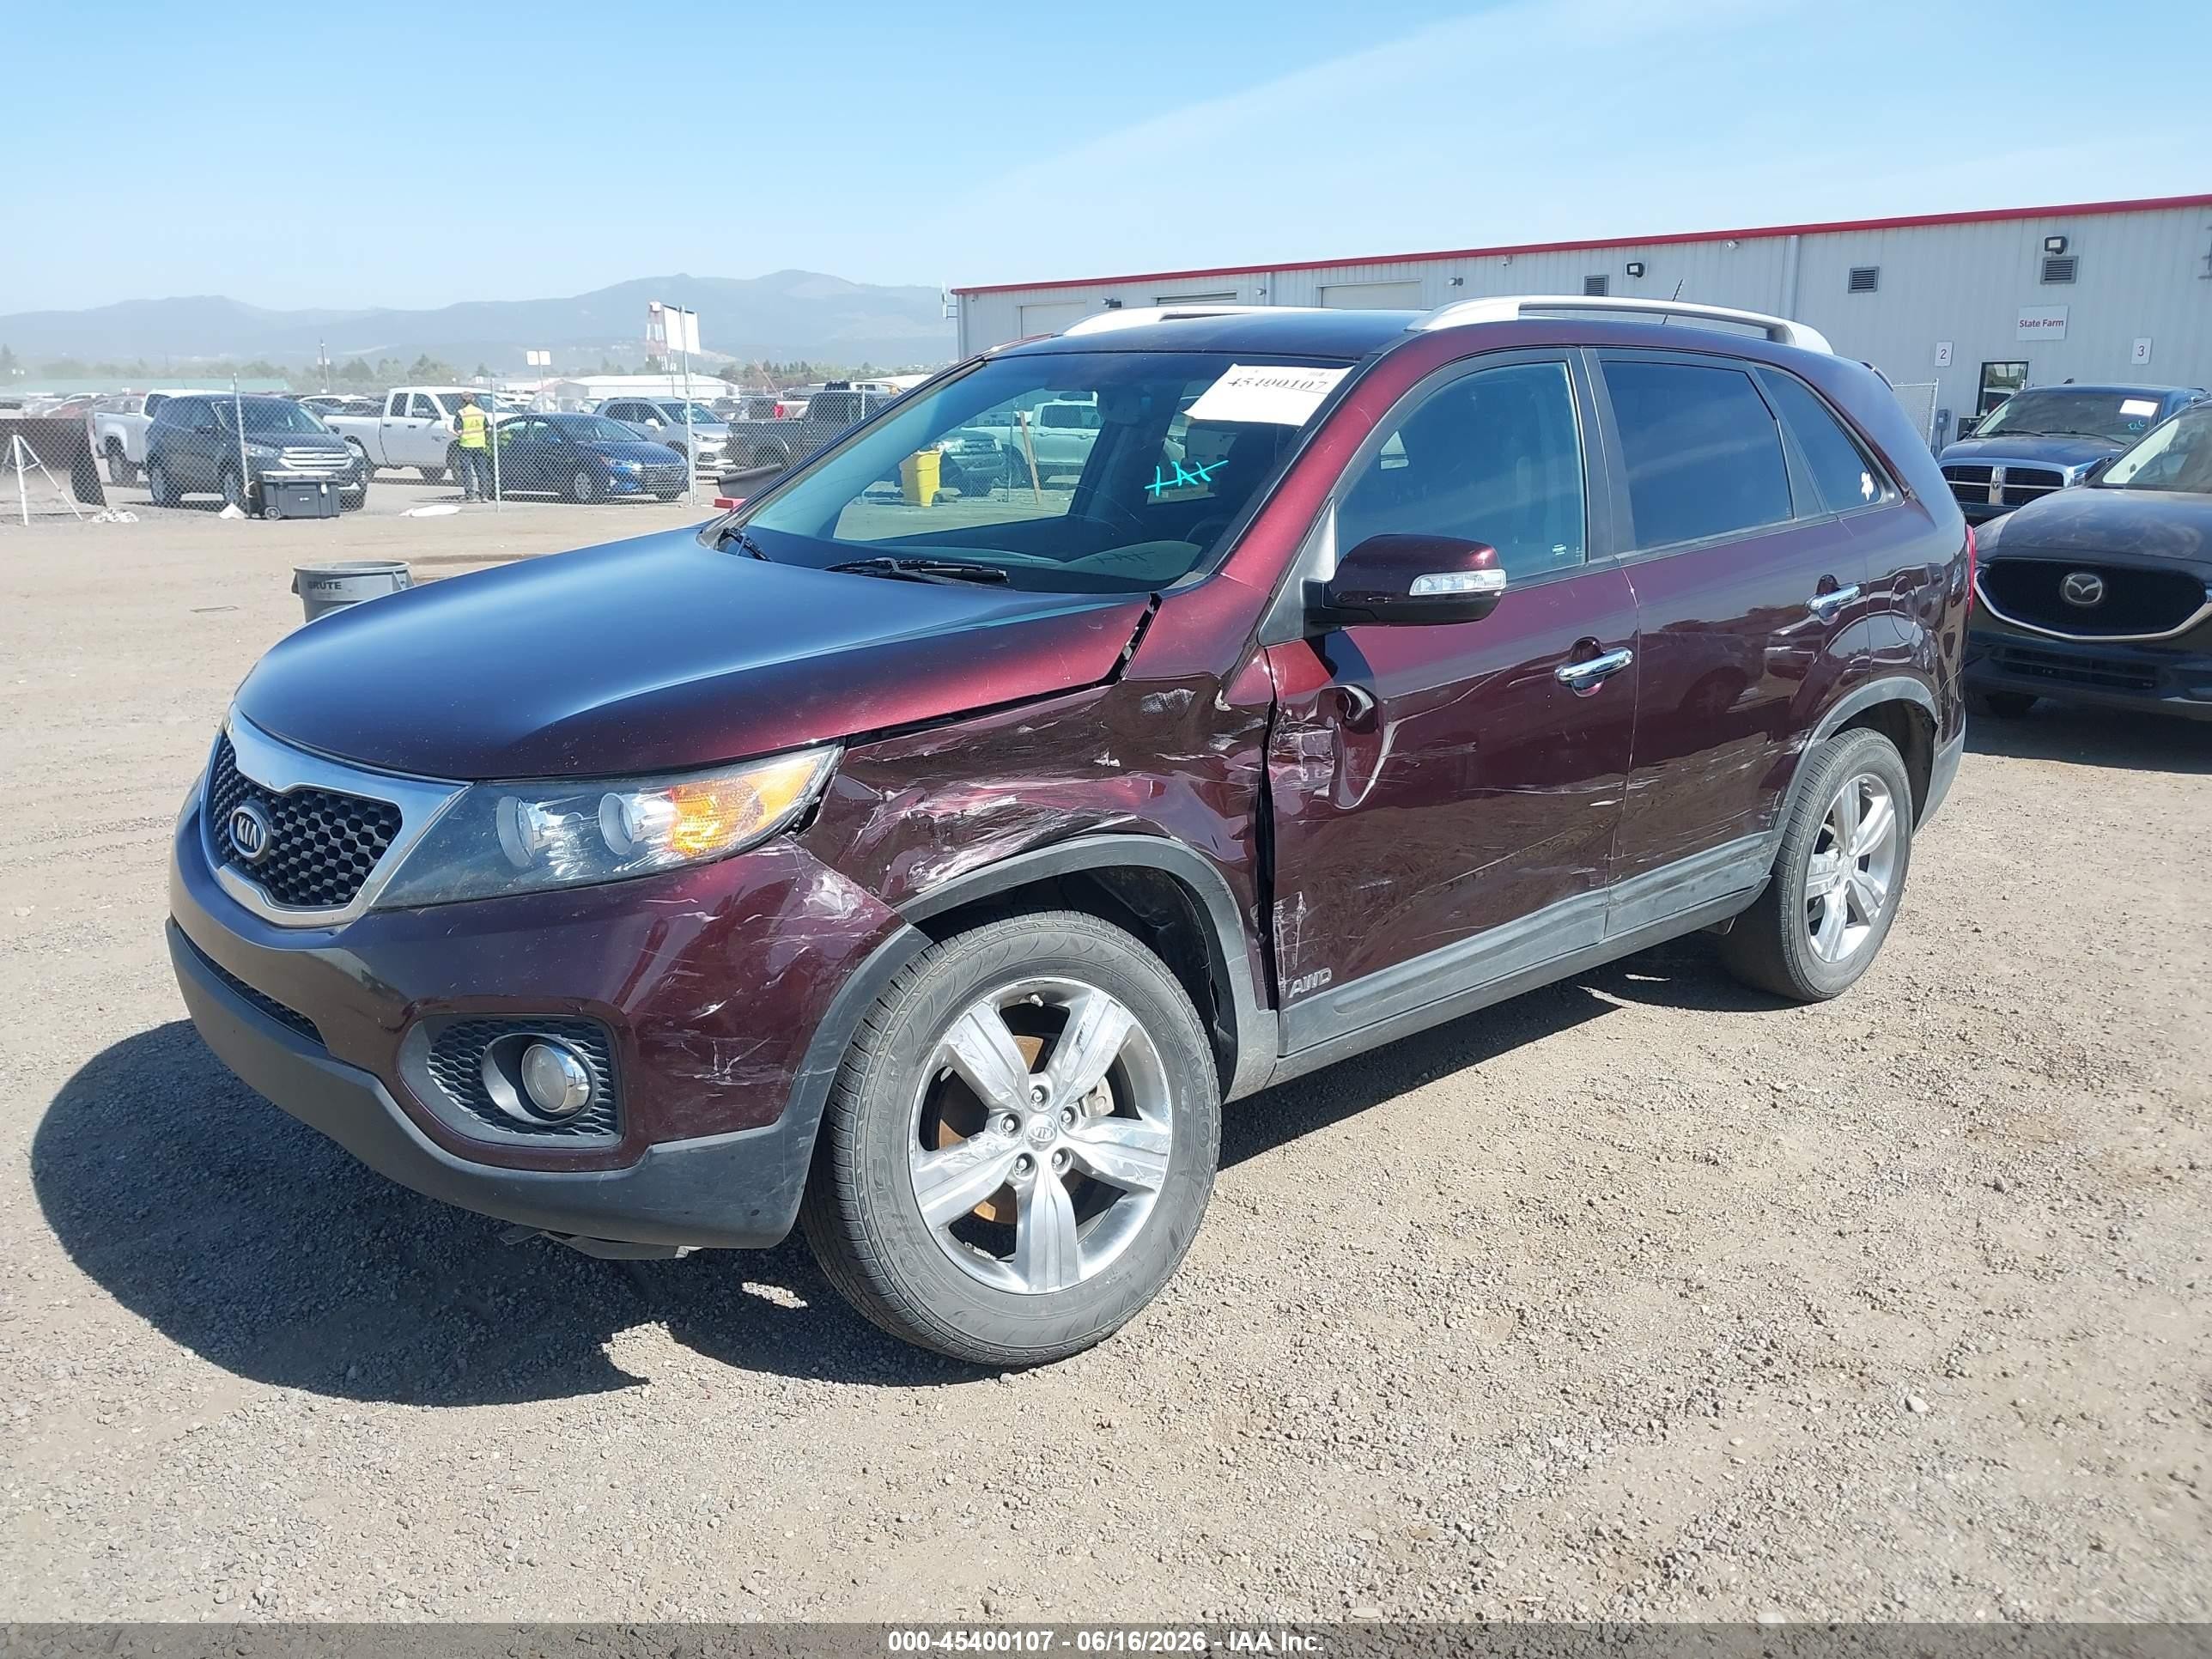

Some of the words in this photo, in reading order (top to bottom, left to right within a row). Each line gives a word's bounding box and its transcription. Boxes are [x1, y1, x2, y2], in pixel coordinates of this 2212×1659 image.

[2020, 319, 2041, 328] State
[2043, 319, 2064, 327] Farm
[1940, 349, 1948, 360] 2
[2137, 344, 2145, 357] 3
[307, 580, 342, 590] BRUTE
[236, 816, 258, 850] KIA
[1288, 967, 1332, 998] AWD
